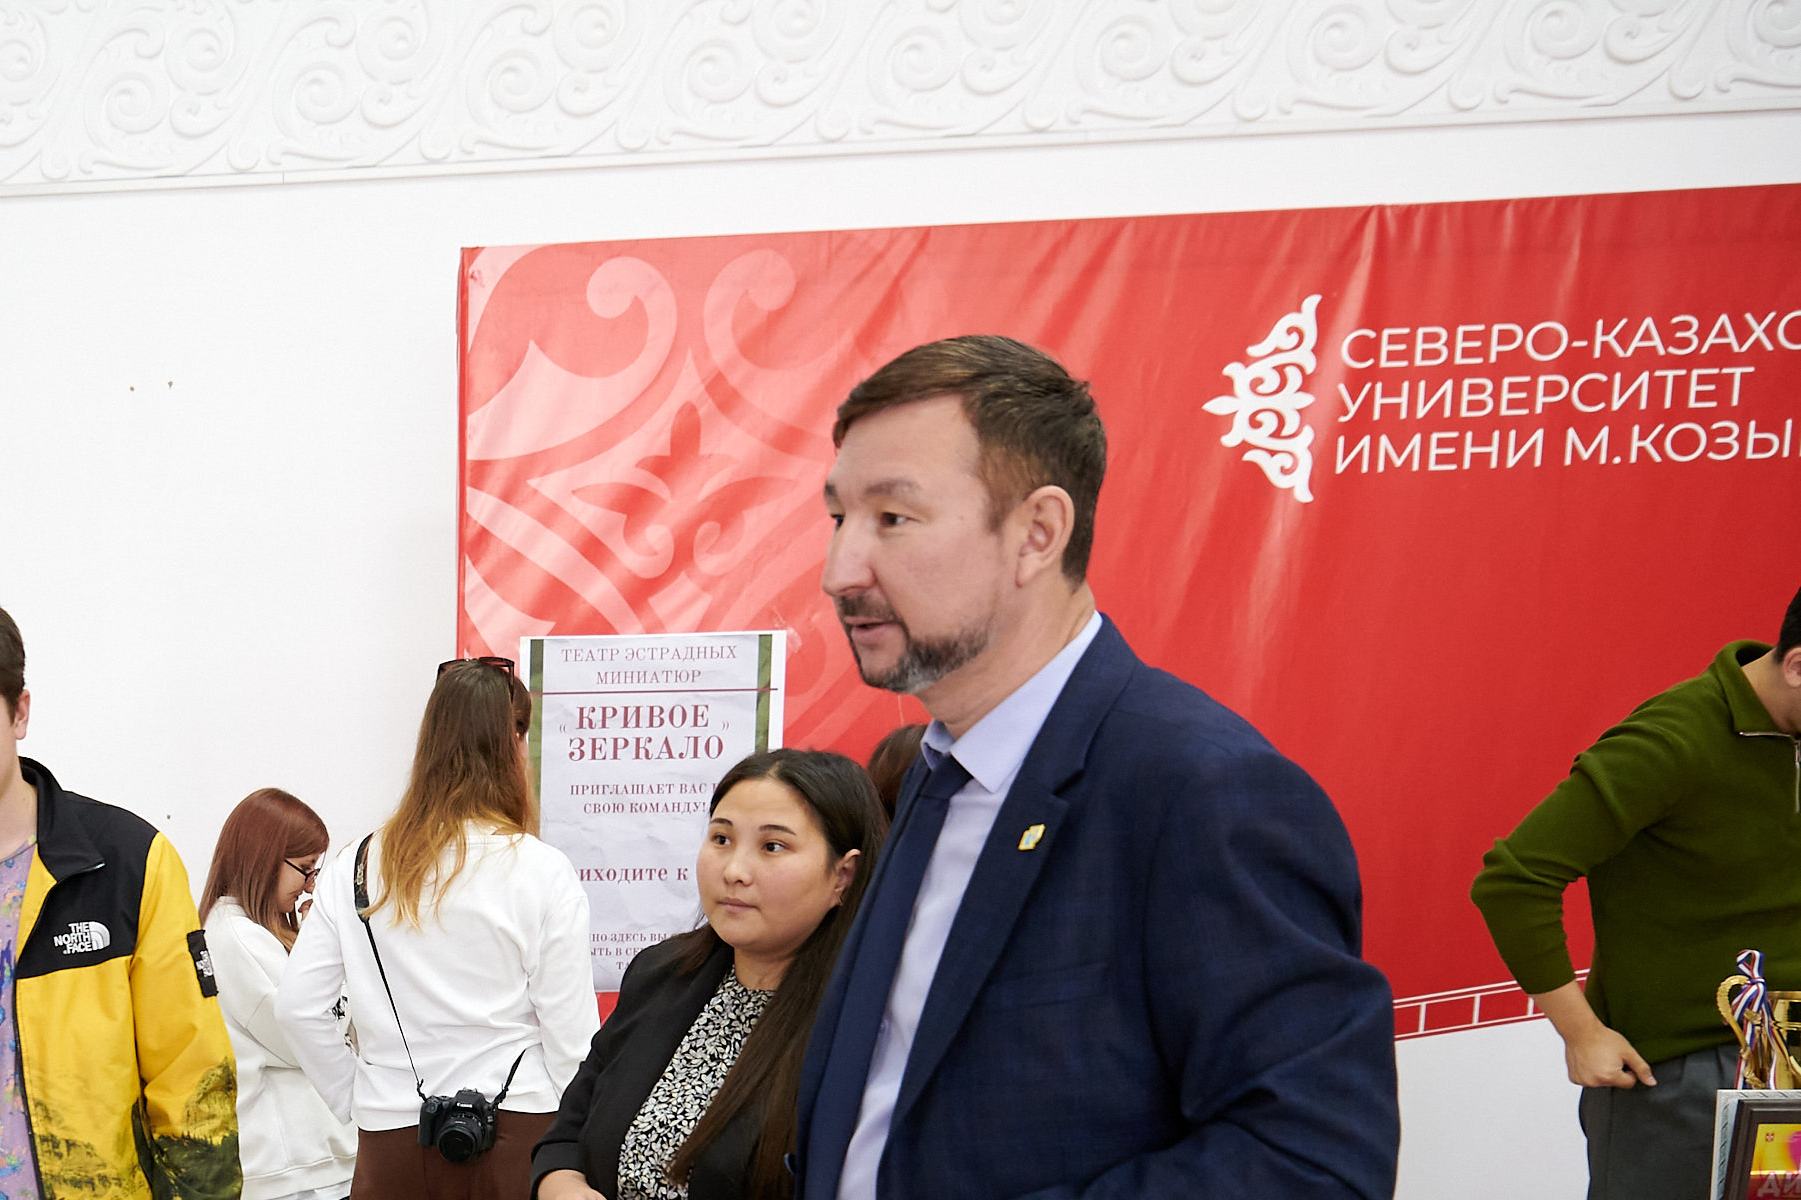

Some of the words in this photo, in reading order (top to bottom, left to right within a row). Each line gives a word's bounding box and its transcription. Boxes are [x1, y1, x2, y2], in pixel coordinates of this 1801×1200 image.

[1337, 366, 1756, 423] УНИВЕРСИТЕТ
[1335, 427, 1544, 474] ИМЕНИ
[1563, 418, 1801, 466] М.КОЗЫ
[563, 648, 620, 662] ТЕАТР
[625, 645, 737, 662] ЭСТРАДНЫХ
[596, 670, 702, 685] МИНИАТЮР
[575, 704, 709, 729] КРИВОЕ
[569, 735, 724, 761] ЗЕРКАЛО
[570, 784, 674, 795] ПРИГЛАШАЕТ
[679, 783, 707, 794] ВАС
[583, 803, 625, 814] СВОЮ
[630, 802, 706, 814] КОМАНДУ!
[579, 868, 668, 884] иходите
[68, 921, 90, 933] THE
[53, 931, 91, 947] NORTH
[66, 942, 93, 954] FACE
